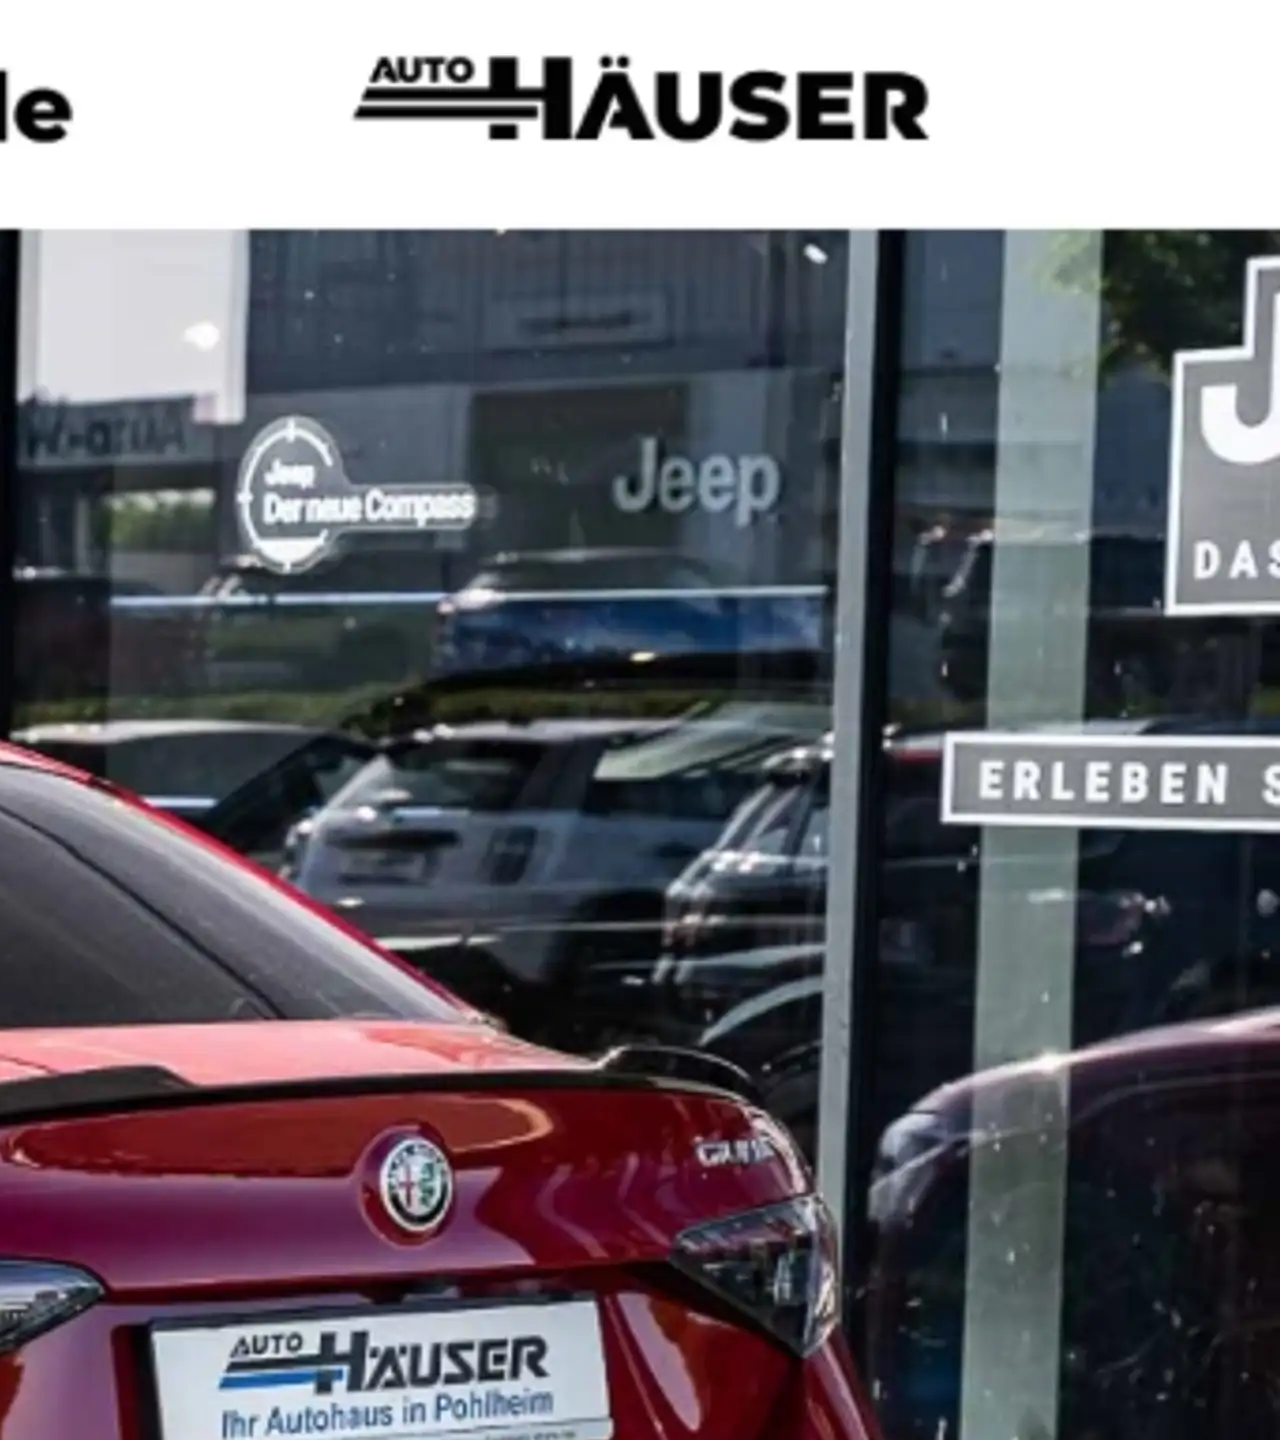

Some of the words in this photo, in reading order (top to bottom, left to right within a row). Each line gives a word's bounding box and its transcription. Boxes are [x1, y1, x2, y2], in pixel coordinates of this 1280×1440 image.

[264, 459, 316, 489] Jeep
[612, 435, 781, 528] Jeep
[263, 493, 304, 524] Der
[306, 496, 362, 522] neue
[364, 488, 477, 528] Compass
[978, 759, 1229, 805] ERLEBEN
[230, 1333, 304, 1358] AUTO
[313, 1330, 551, 1395] HÄUSER
[222, 1409, 257, 1440] Ihr
[264, 1401, 394, 1438] Autohaus
[402, 1395, 427, 1425] in
[433, 1387, 555, 1422] Pohlheim
